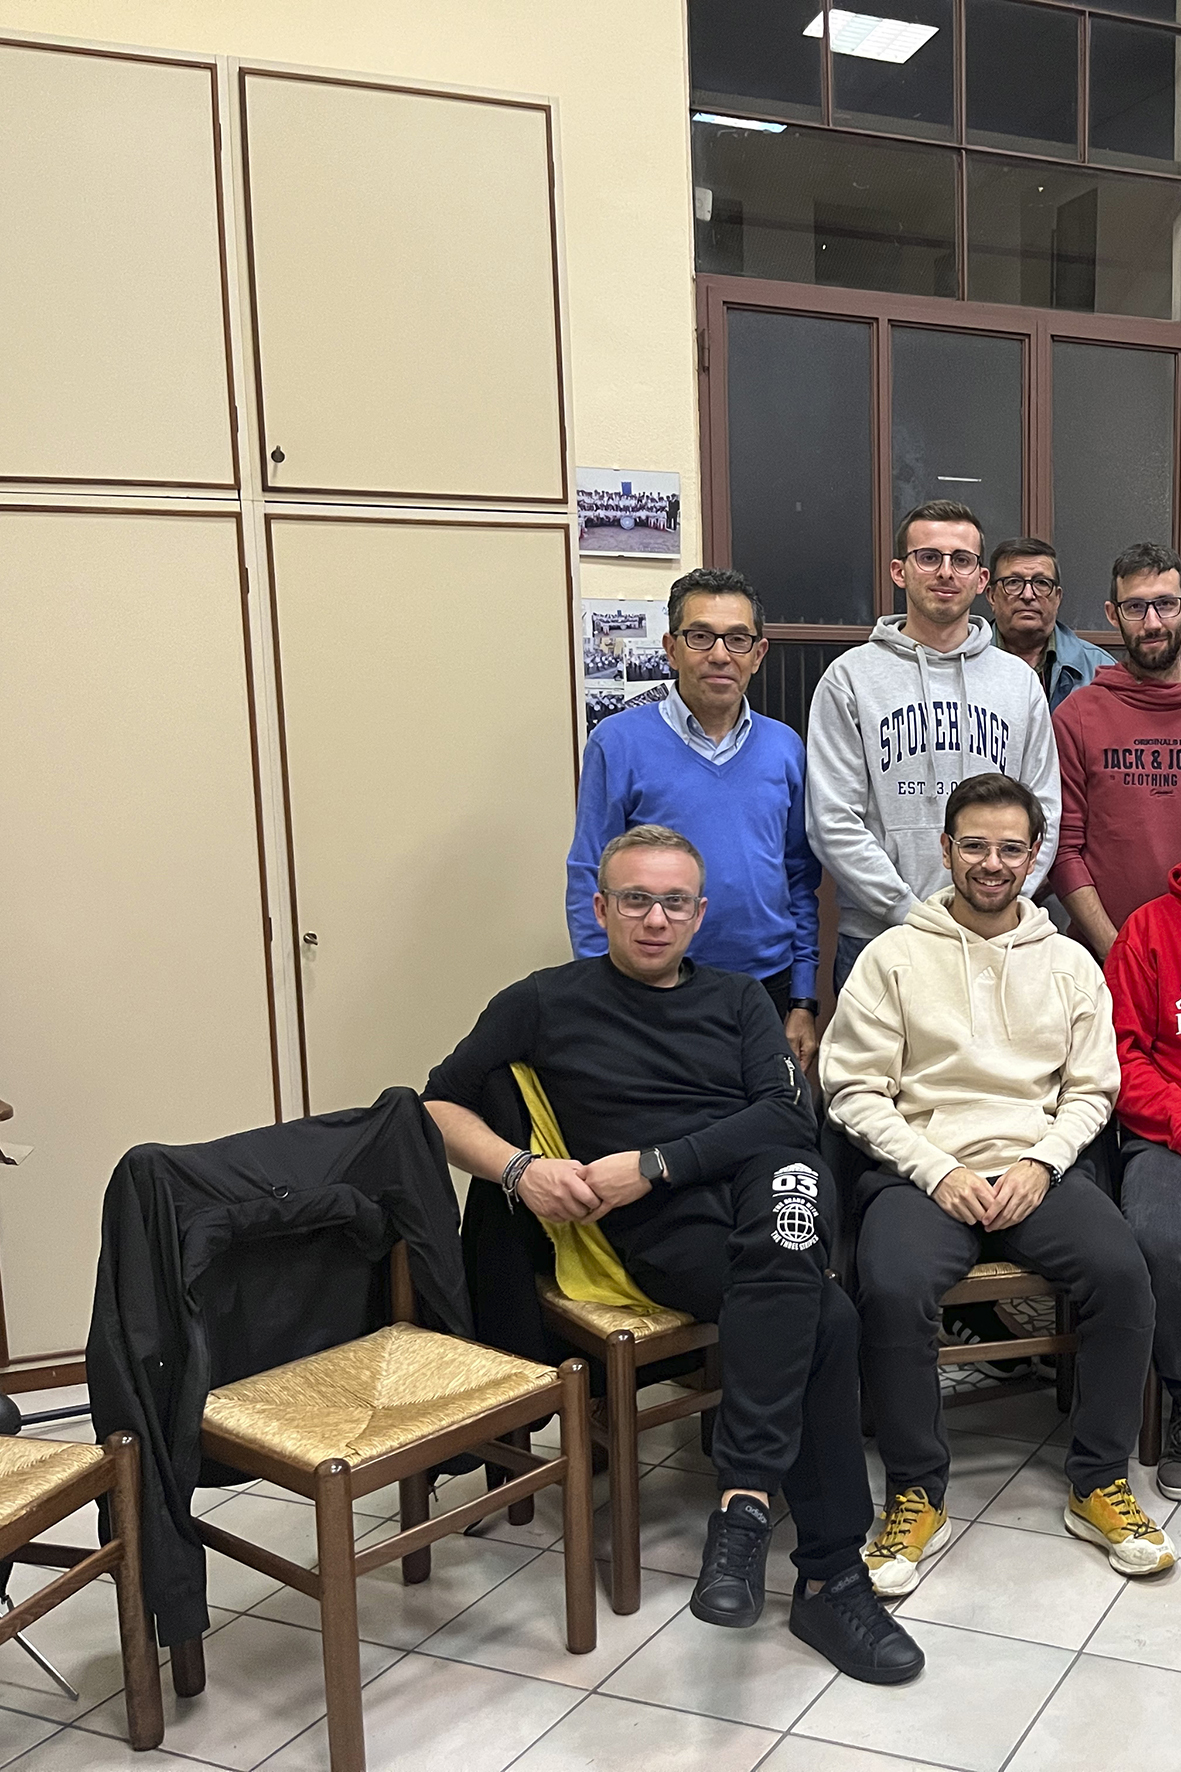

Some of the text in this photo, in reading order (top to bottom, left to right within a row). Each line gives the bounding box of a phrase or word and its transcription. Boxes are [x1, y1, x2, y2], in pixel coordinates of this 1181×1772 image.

[1103, 748, 1145, 770] JACK
[1151, 749, 1162, 770] &
[1123, 773, 1178, 787] CLOTHING
[772, 1174, 818, 1197] 03
[831, 1573, 860, 1593] adidas
